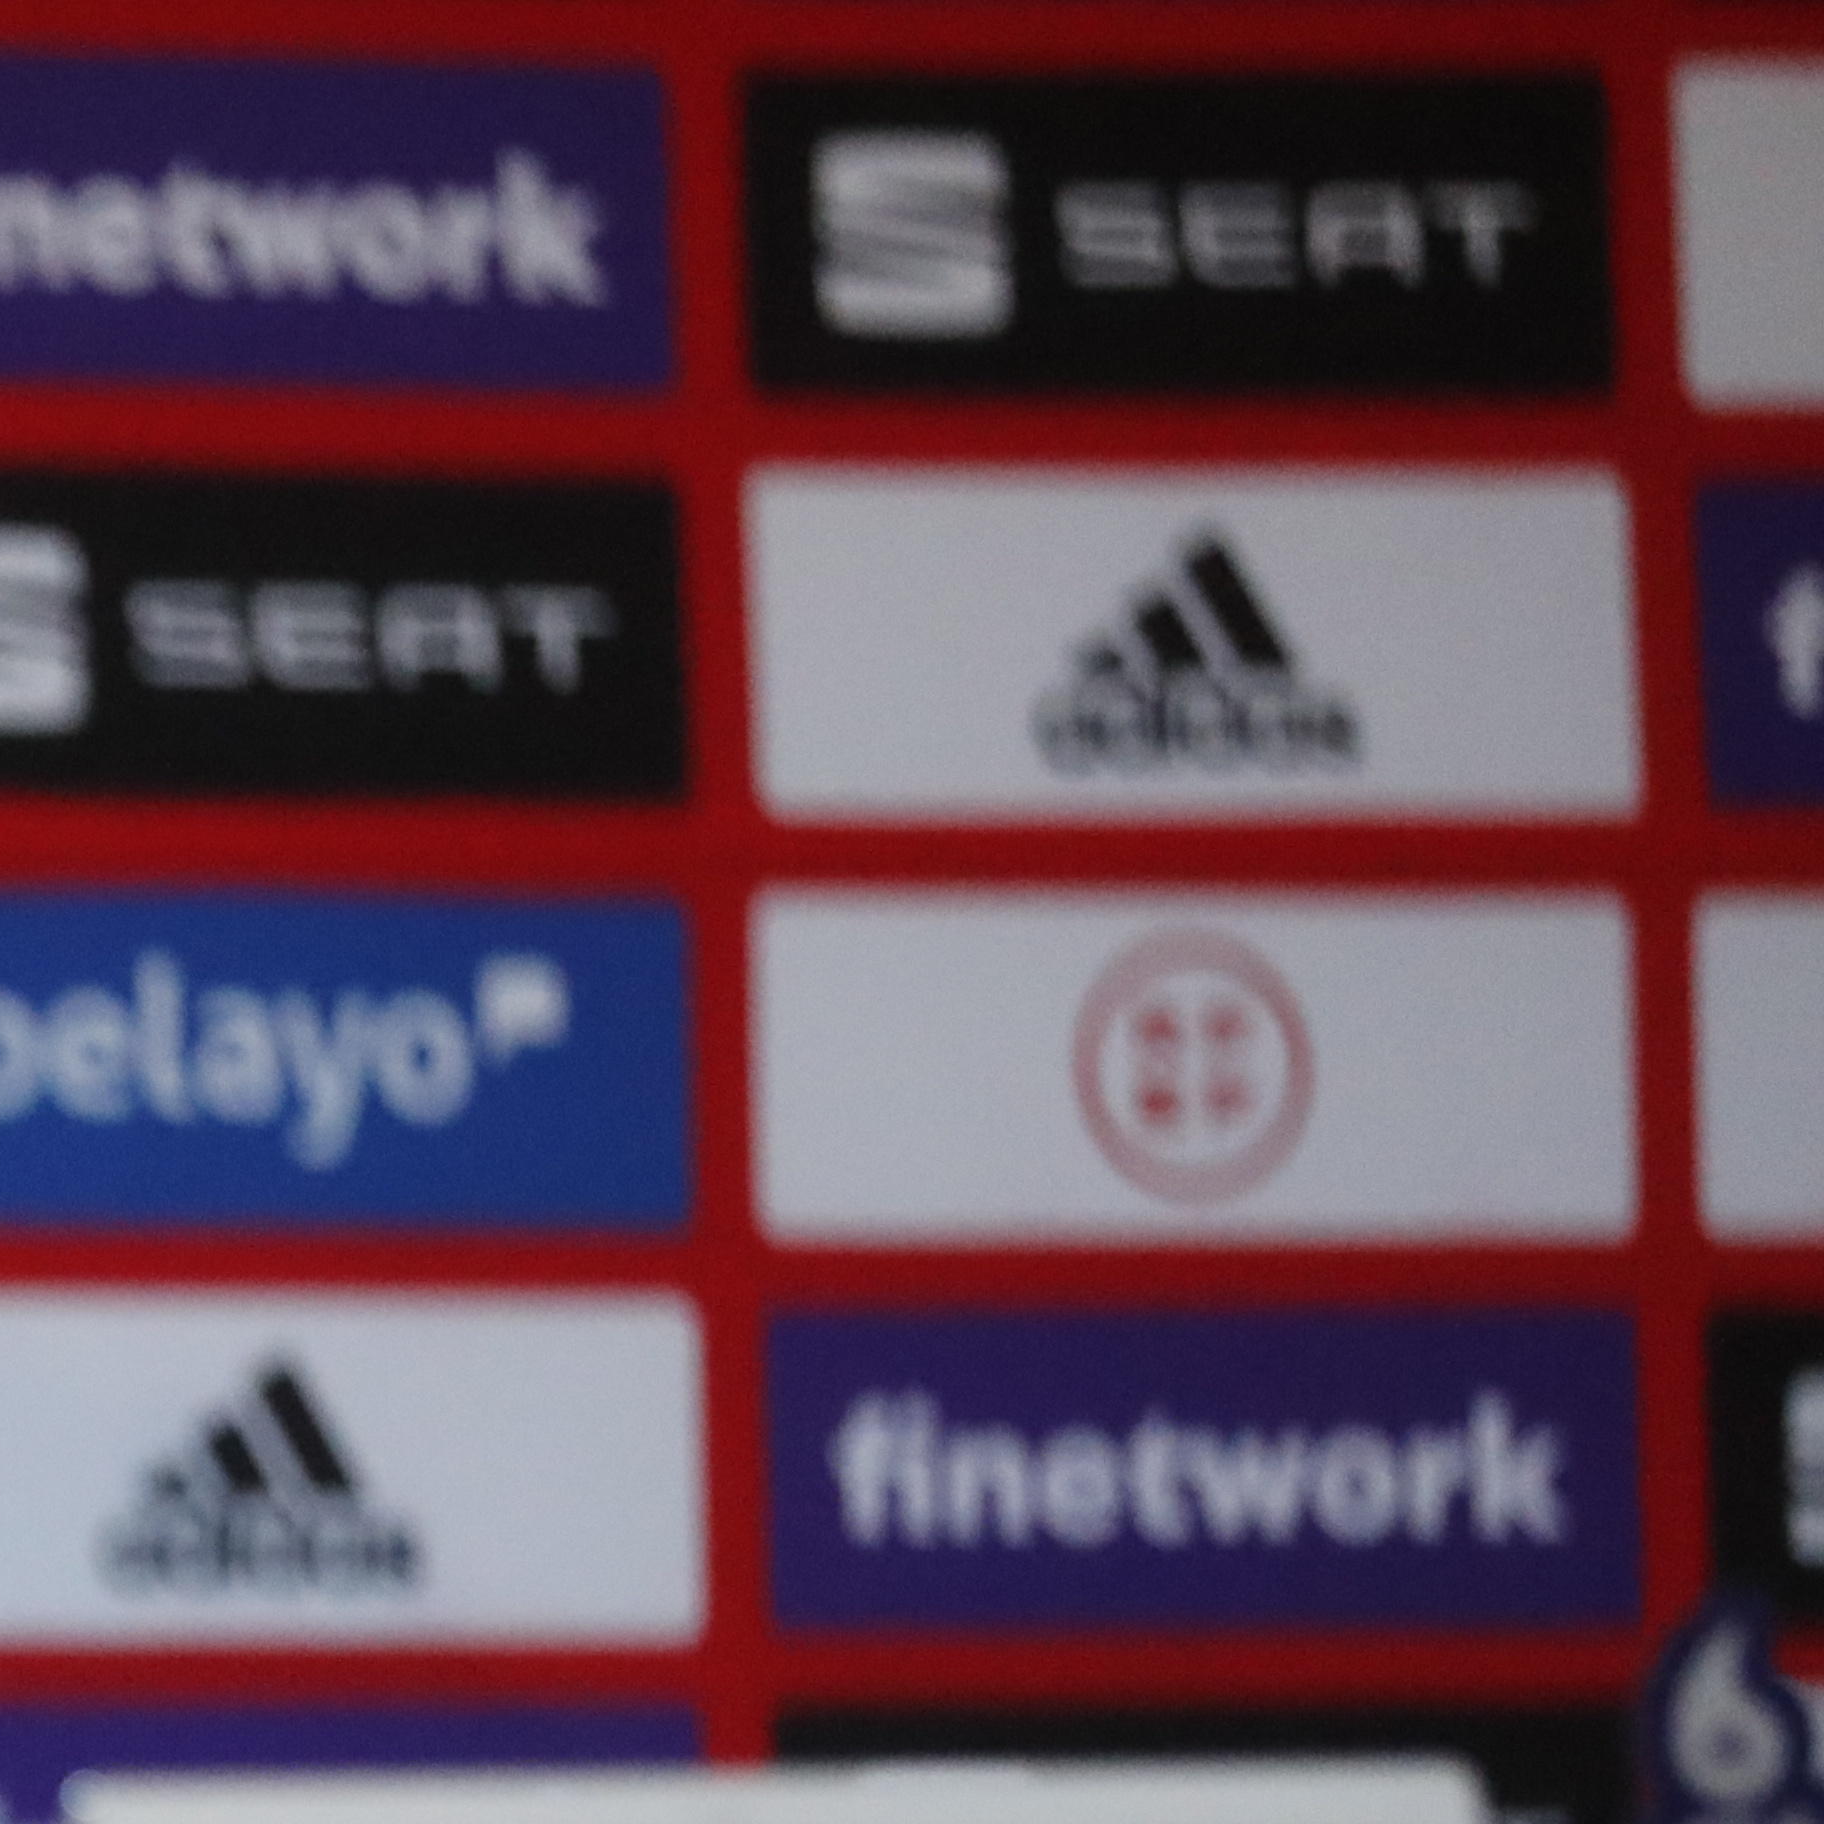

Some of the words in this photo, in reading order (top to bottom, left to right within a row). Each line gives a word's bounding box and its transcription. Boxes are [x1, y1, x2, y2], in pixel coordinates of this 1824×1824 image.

[1054, 183, 1532, 288] SEAT
[124, 580, 607, 690] SEAT
[828, 1394, 1560, 1546] finetwork
